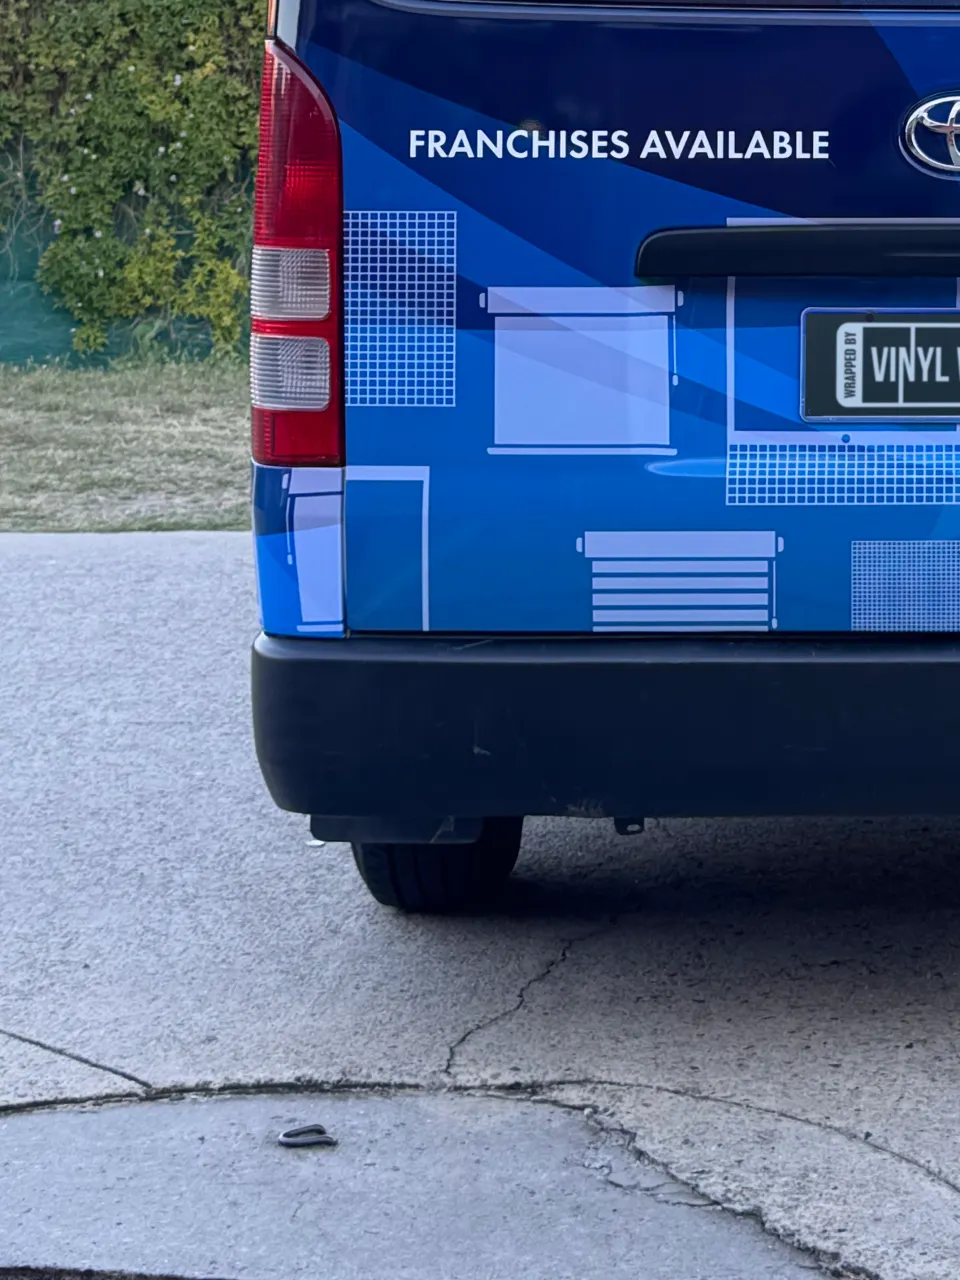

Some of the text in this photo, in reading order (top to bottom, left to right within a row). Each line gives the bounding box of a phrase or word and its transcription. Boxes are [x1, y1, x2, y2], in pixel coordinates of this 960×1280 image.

[409, 129, 829, 160] FRANCHISES AVAILABLE
[843, 331, 857, 399] WRAPPED BY
[870, 346, 950, 383] VINYL
